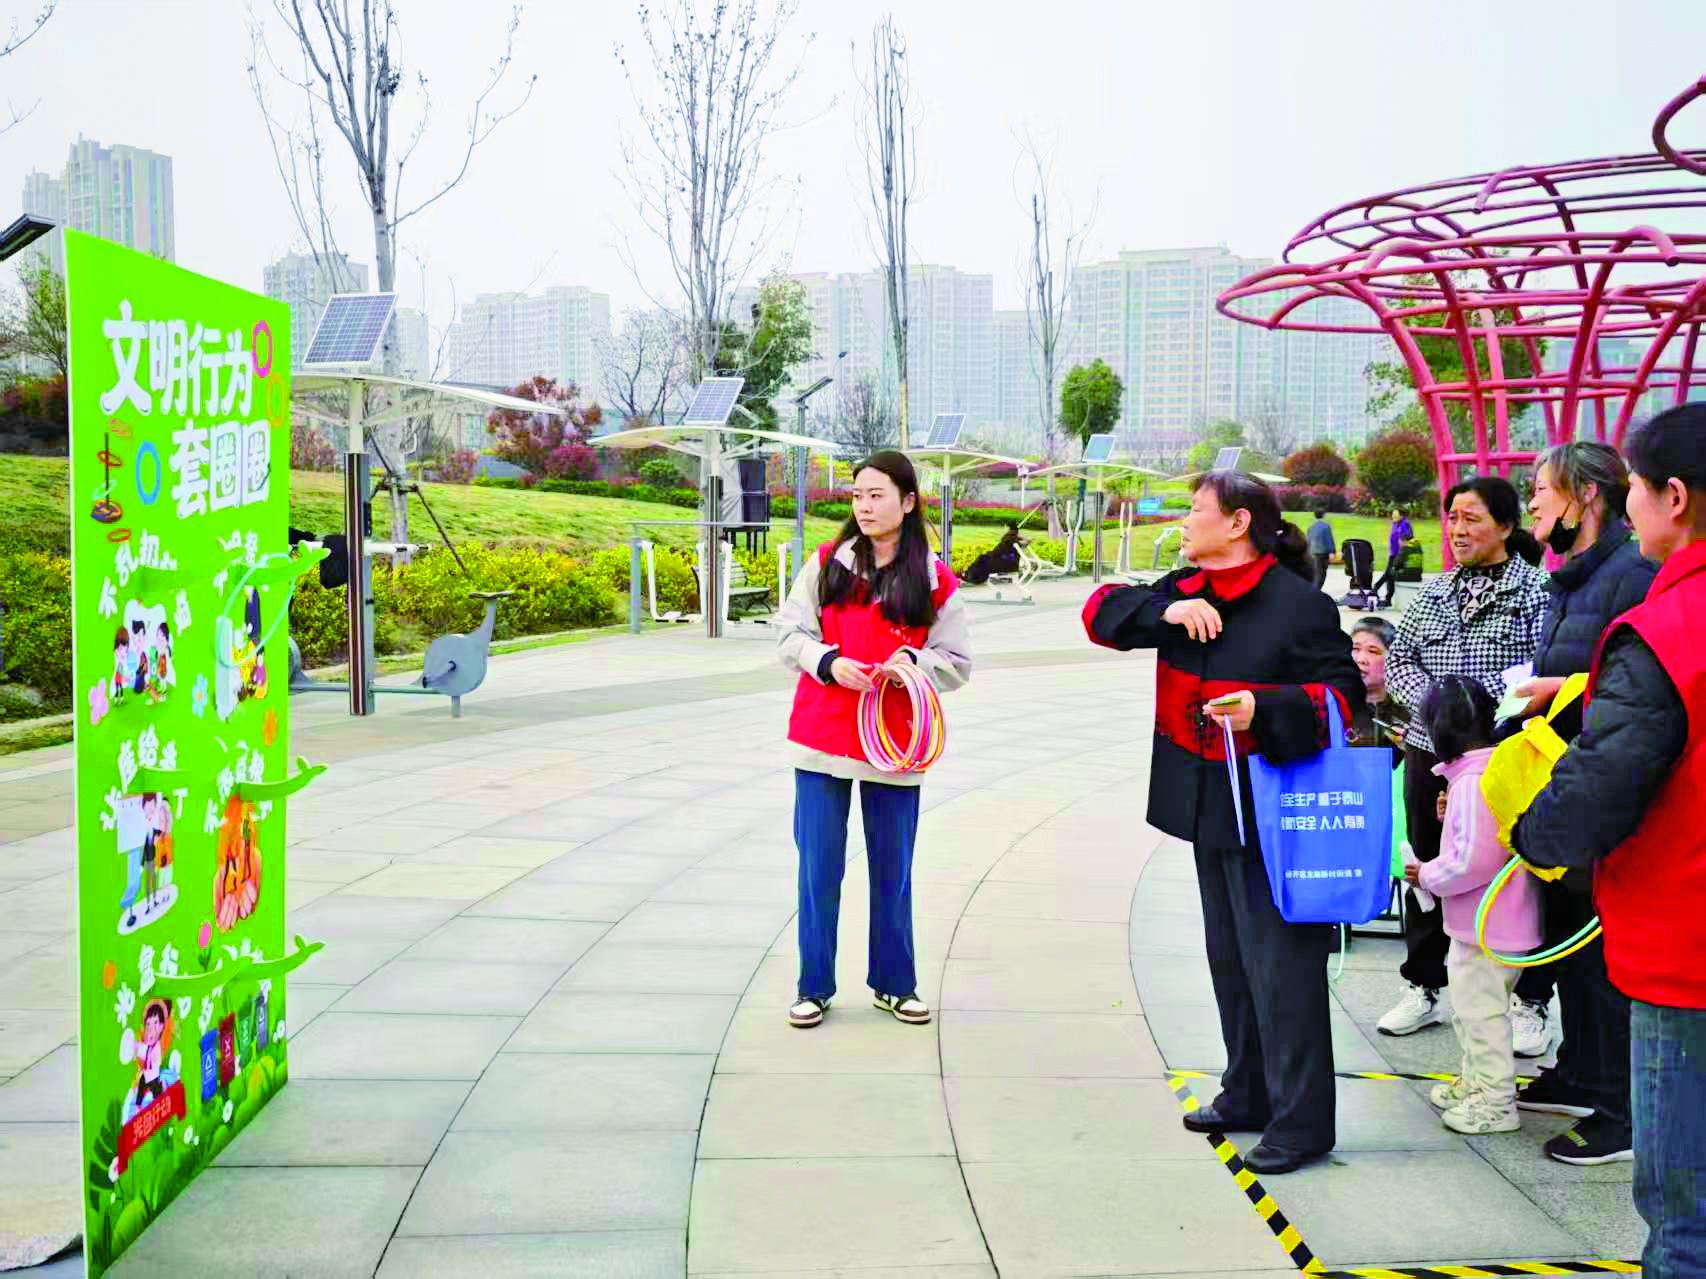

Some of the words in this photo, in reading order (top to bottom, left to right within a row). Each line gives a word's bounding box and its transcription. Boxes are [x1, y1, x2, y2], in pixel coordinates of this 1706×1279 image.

[100, 299, 253, 417] 文明行为
[169, 418, 271, 519] 套圈圈
